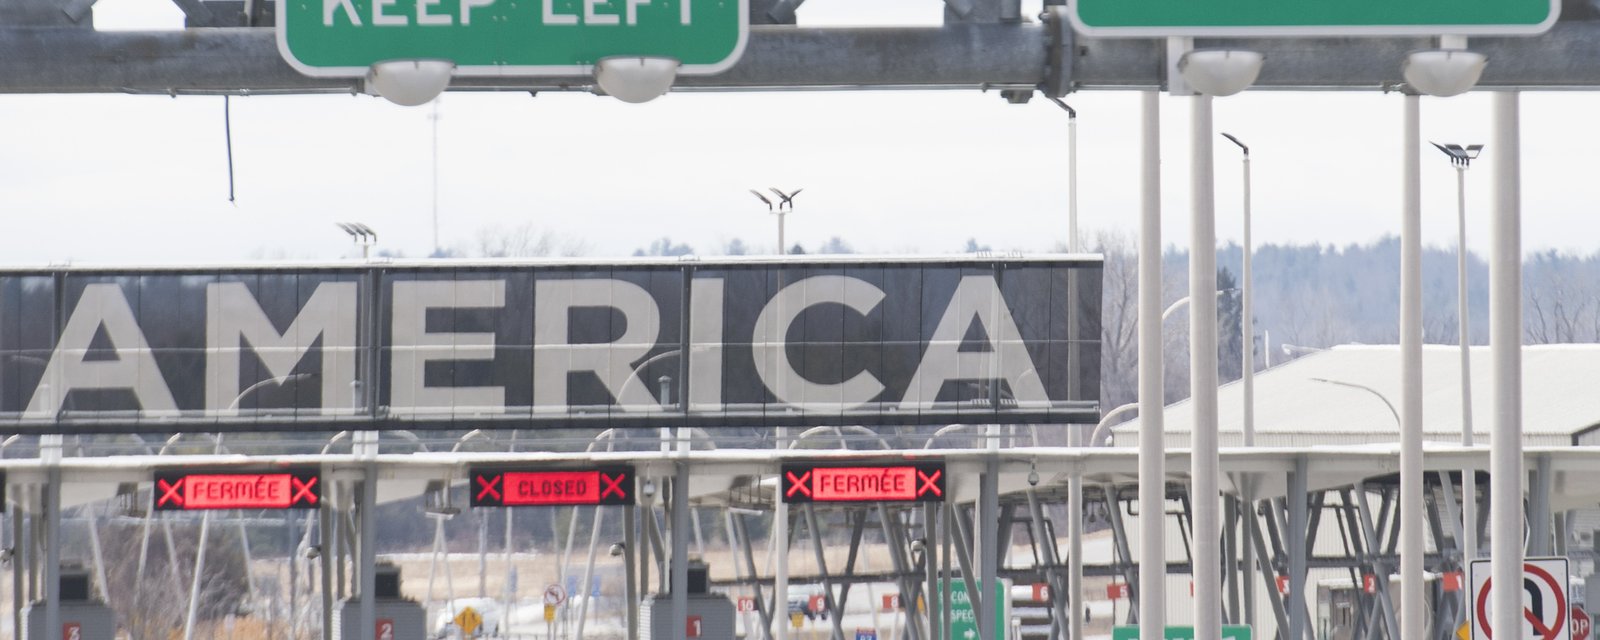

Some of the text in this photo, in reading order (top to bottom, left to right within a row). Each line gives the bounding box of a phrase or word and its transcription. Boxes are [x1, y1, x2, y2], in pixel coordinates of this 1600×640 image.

[22, 275, 1052, 418] AMERICA
[193, 476, 280, 500] FERMÉE
[518, 480, 587, 497] CLOSED
[820, 469, 906, 493] FERMÉE
[1040, 585, 1048, 601] 6
[1119, 585, 1128, 598] 5
[741, 599, 754, 612] 10
[816, 597, 825, 611] 9
[381, 623, 392, 640] 2
[693, 619, 701, 637] 1
[1571, 619, 1588, 635] OP
